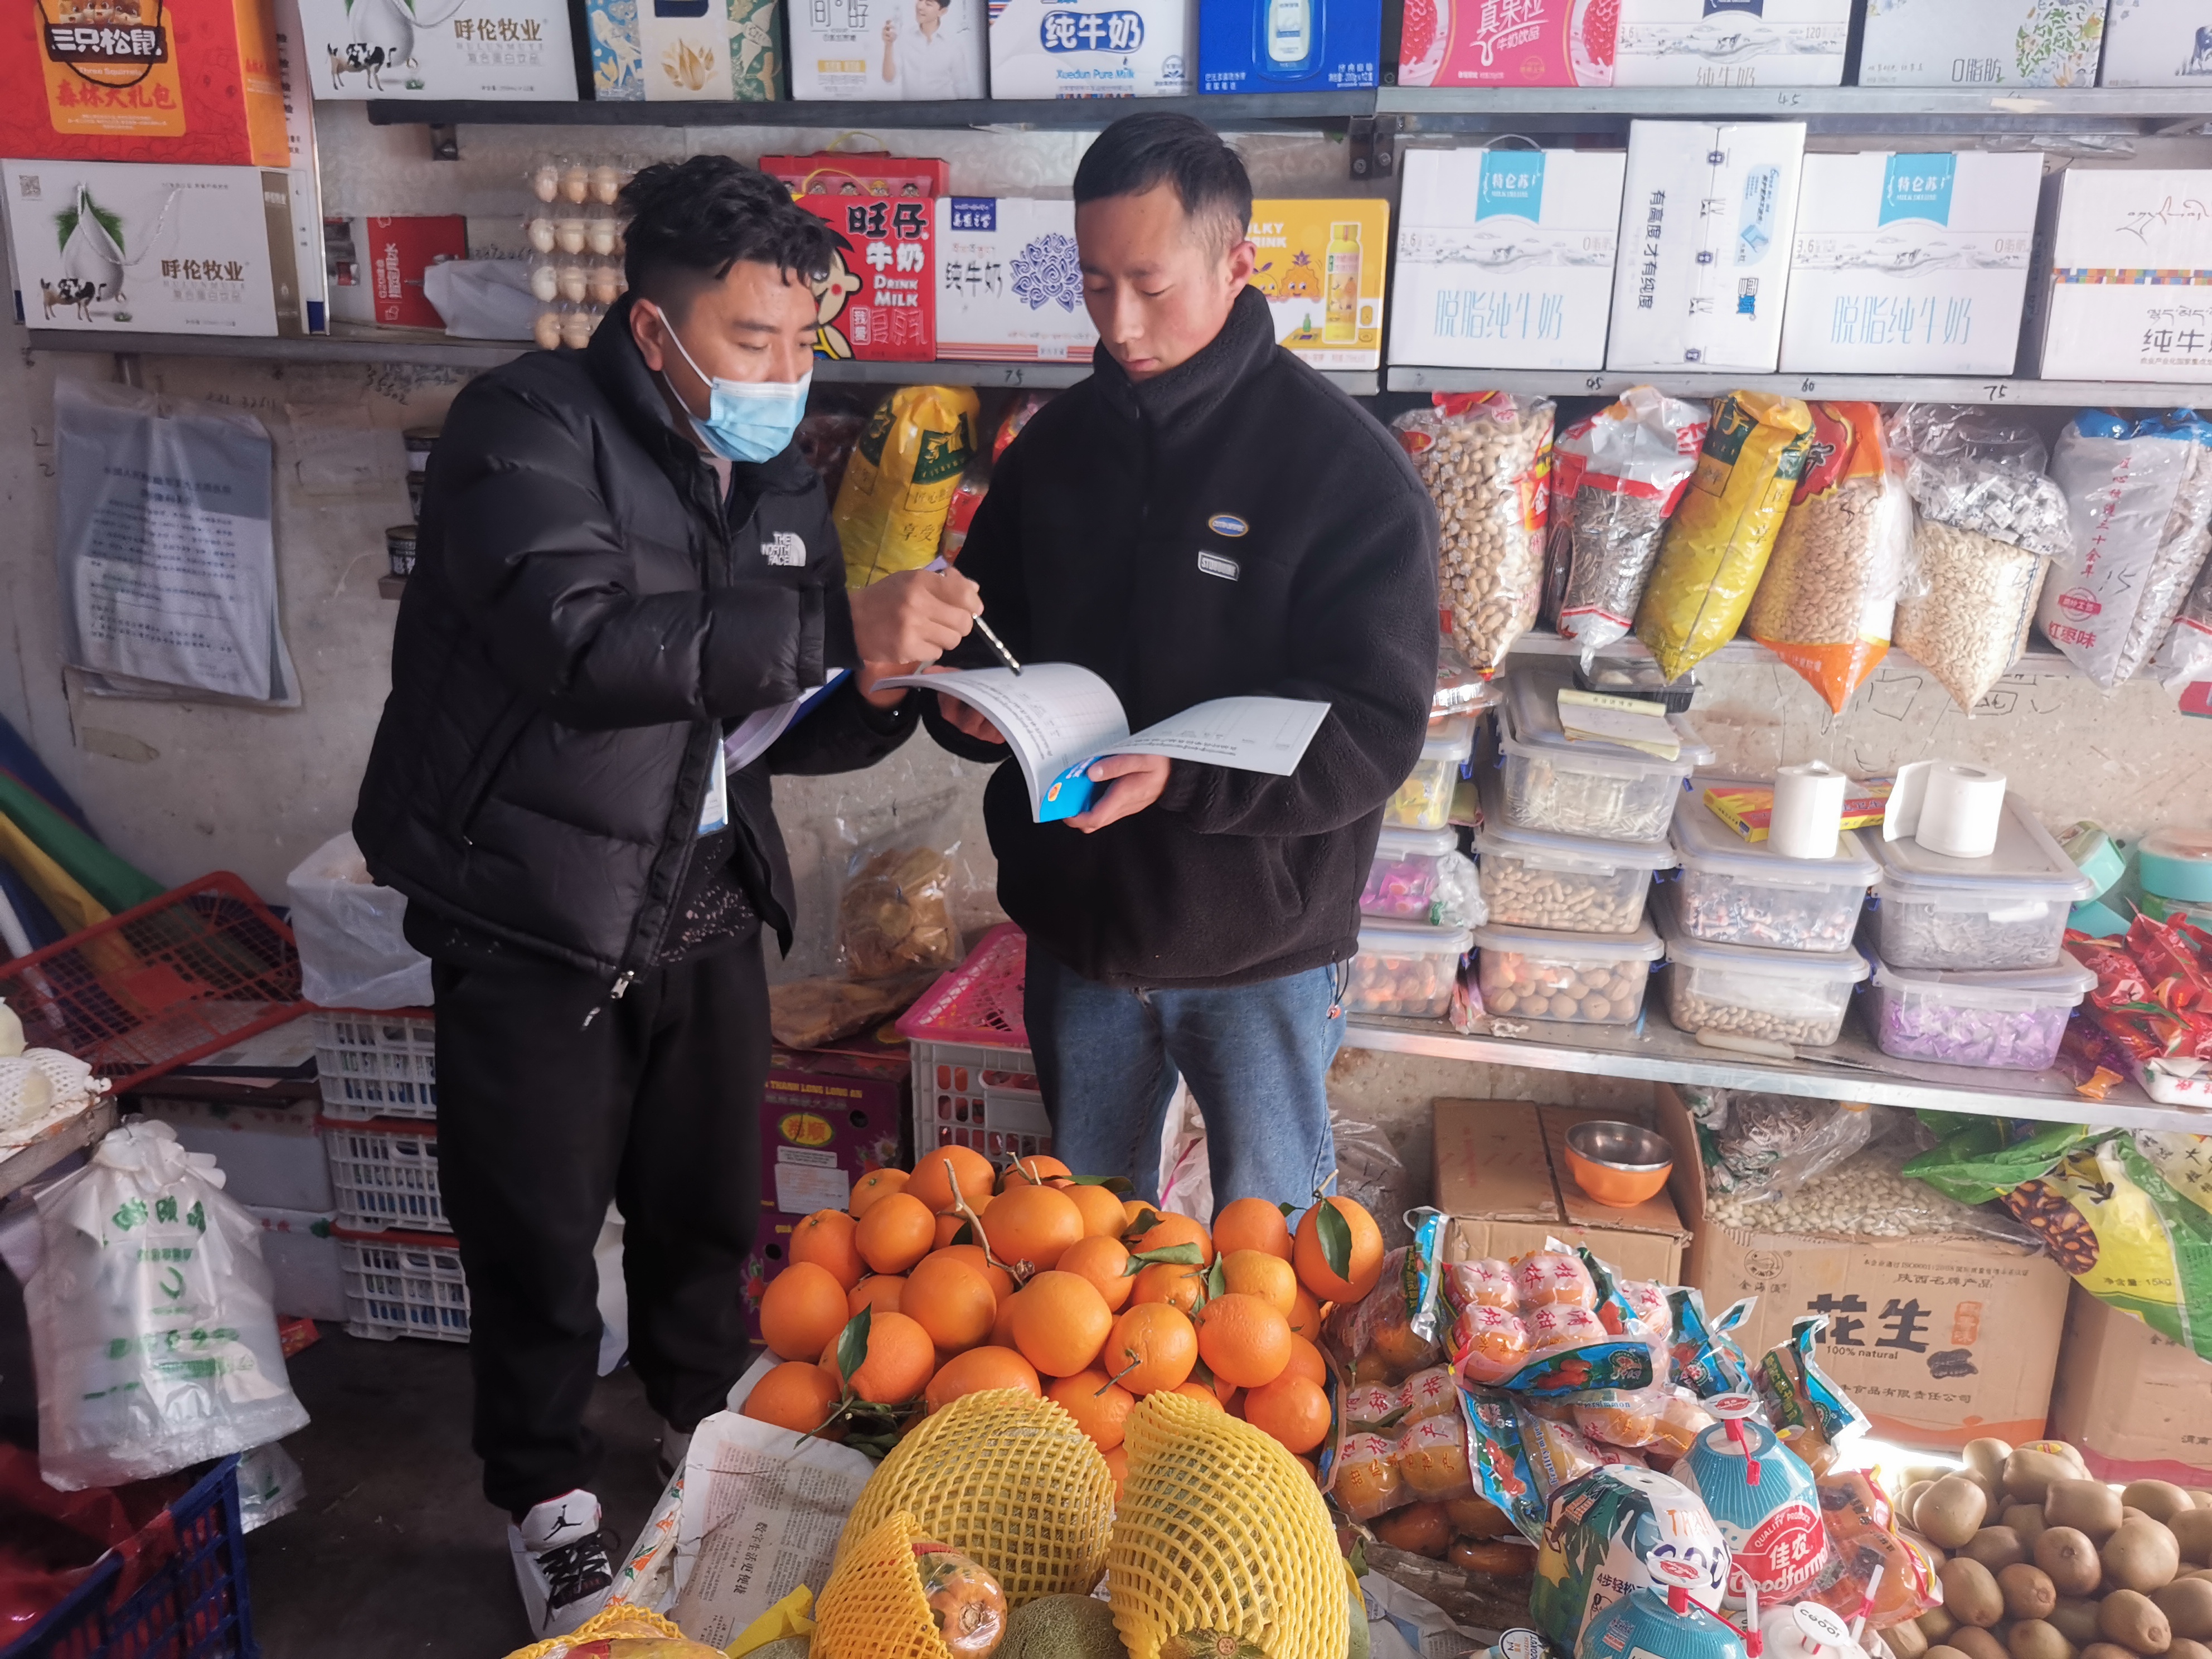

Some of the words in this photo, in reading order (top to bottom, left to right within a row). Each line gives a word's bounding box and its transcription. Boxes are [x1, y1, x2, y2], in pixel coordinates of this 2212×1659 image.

[51, 28, 162, 55] 三只松鼠
[454, 18, 542, 41] 呼伦牧业
[1045, 14, 1142, 49] 纯牛奶
[1093, 69, 1113, 79] Pure
[1952, 59, 2004, 83] 0脂肪
[846, 201, 928, 240] 旺仔
[866, 241, 924, 273] 牛奶
[161, 259, 244, 282] 呼伦牧业
[874, 274, 918, 289] DRINK
[874, 291, 918, 307] MILK
[1434, 289, 1564, 341] 脱脂纯牛奶
[1831, 295, 1972, 345] 脱脂纯牛奶
[2141, 329, 2212, 353] 纯牛
[760, 543, 791, 556] NORTH
[773, 531, 791, 545] THE
[768, 555, 790, 566] FACE
[2049, 620, 2097, 649] 红枣味
[1808, 1293, 1932, 1354] 花生
[1827, 1345, 1855, 1357] 100%
[1858, 1346, 1898, 1360] natural
[1754, 1513, 1786, 1548] QUALITY
[733, 1521, 768, 1595] 数字生活更便捷
[1769, 1532, 1811, 1571] 佳农
